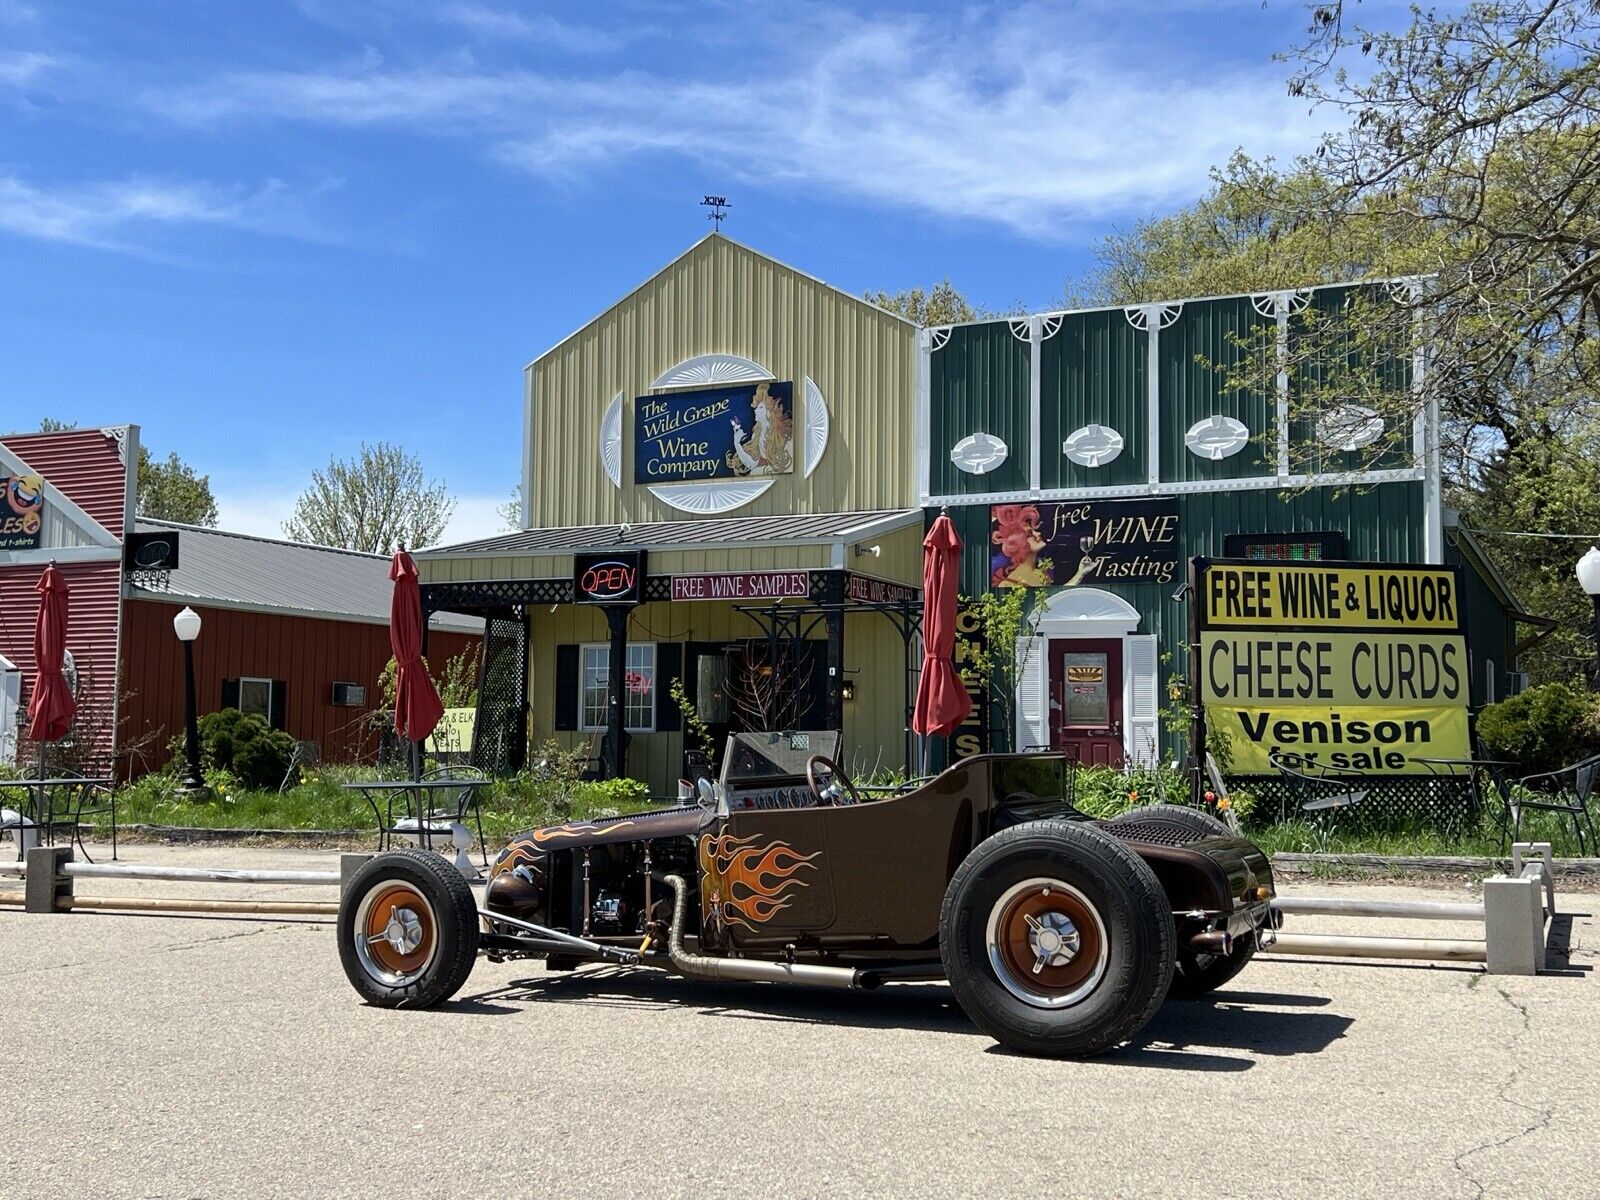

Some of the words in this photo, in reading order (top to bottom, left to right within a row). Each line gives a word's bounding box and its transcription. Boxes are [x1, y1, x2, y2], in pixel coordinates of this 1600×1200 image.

[641, 400, 668, 418] The
[643, 410, 680, 438] Wild
[683, 398, 730, 423] Grape
[657, 437, 709, 458] Wine
[647, 458, 720, 478] Company
[1047, 503, 1091, 542] free
[1092, 515, 1178, 545] WINE
[581, 568, 635, 592] OPEN
[1093, 555, 1178, 584] Tasting
[675, 577, 704, 598] FREE
[709, 576, 744, 597] WINE
[749, 573, 806, 596] SAMPLES
[852, 577, 868, 598] FREE
[1211, 570, 1272, 618] FREE
[1278, 572, 1341, 619] WINE
[1345, 582, 1361, 611] &
[1364, 574, 1454, 624] LIQUOR
[1209, 639, 1334, 699] CHEESE
[1351, 641, 1460, 700] CURDS
[459, 712, 474, 723] ELK
[1237, 711, 1431, 744] Venison
[1268, 746, 1318, 768] for
[1330, 747, 1405, 769] sale
